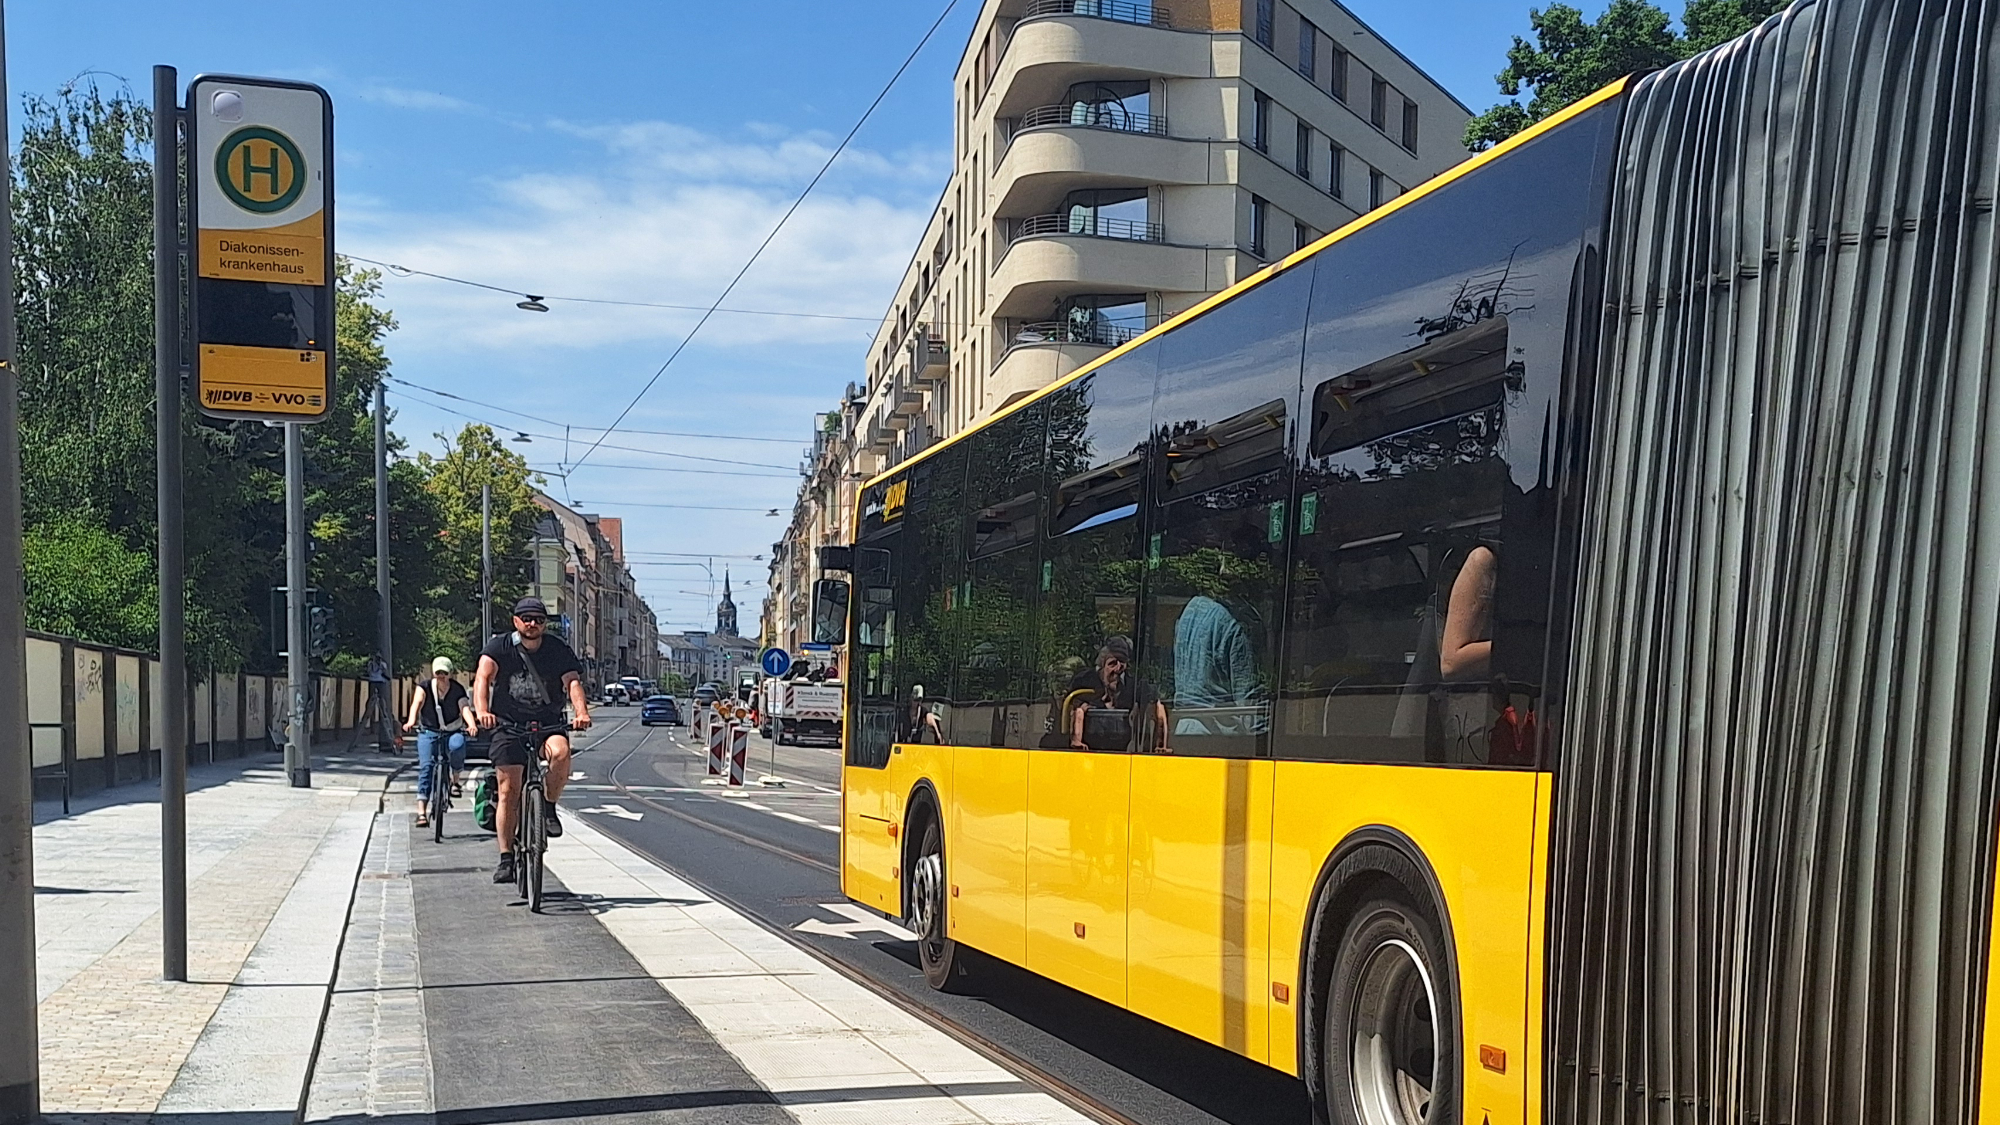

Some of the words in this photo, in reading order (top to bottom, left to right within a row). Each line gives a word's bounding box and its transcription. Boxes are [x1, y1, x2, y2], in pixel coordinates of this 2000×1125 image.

[242, 145, 280, 195] H
[219, 240, 304, 257] Diakonissen-
[219, 257, 304, 274] krankenhaus
[220, 390, 253, 402] DVB
[271, 393, 305, 405] VVO
